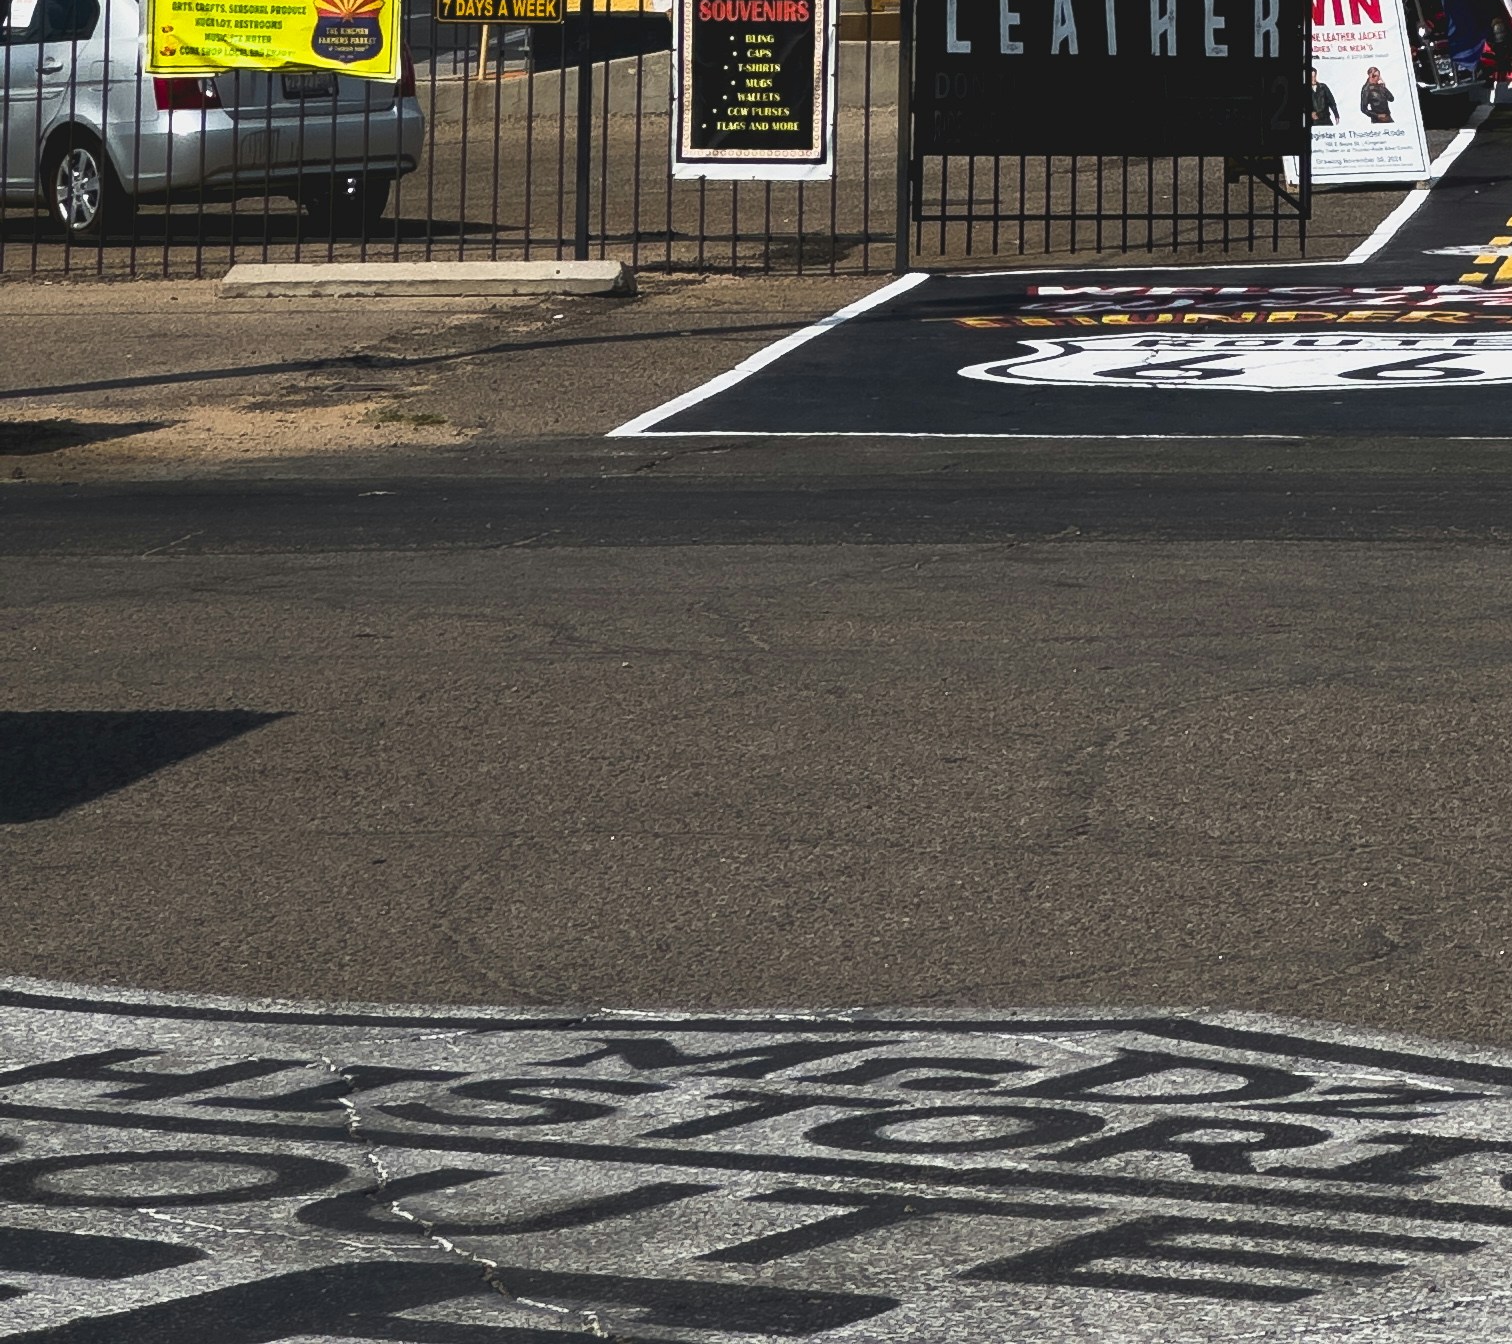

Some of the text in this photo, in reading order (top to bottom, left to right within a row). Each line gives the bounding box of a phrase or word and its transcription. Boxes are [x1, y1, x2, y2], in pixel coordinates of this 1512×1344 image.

[443, 0, 556, 17] 7 DAYS A WEEK
[745, 35, 775, 43] BLING
[1322, 32, 1356, 42] LEATHER
[747, 50, 772, 58] CAPS
[738, 63, 781, 72] T-SHIRTS
[745, 79, 772, 88] MUGS
[737, 92, 781, 102] WALLETS
[717, 122, 745, 131] FLAGS
[749, 122, 769, 131] AND
[1093, 352, 1486, 381] 66
[0, 1148, 1492, 1302] OUTE
